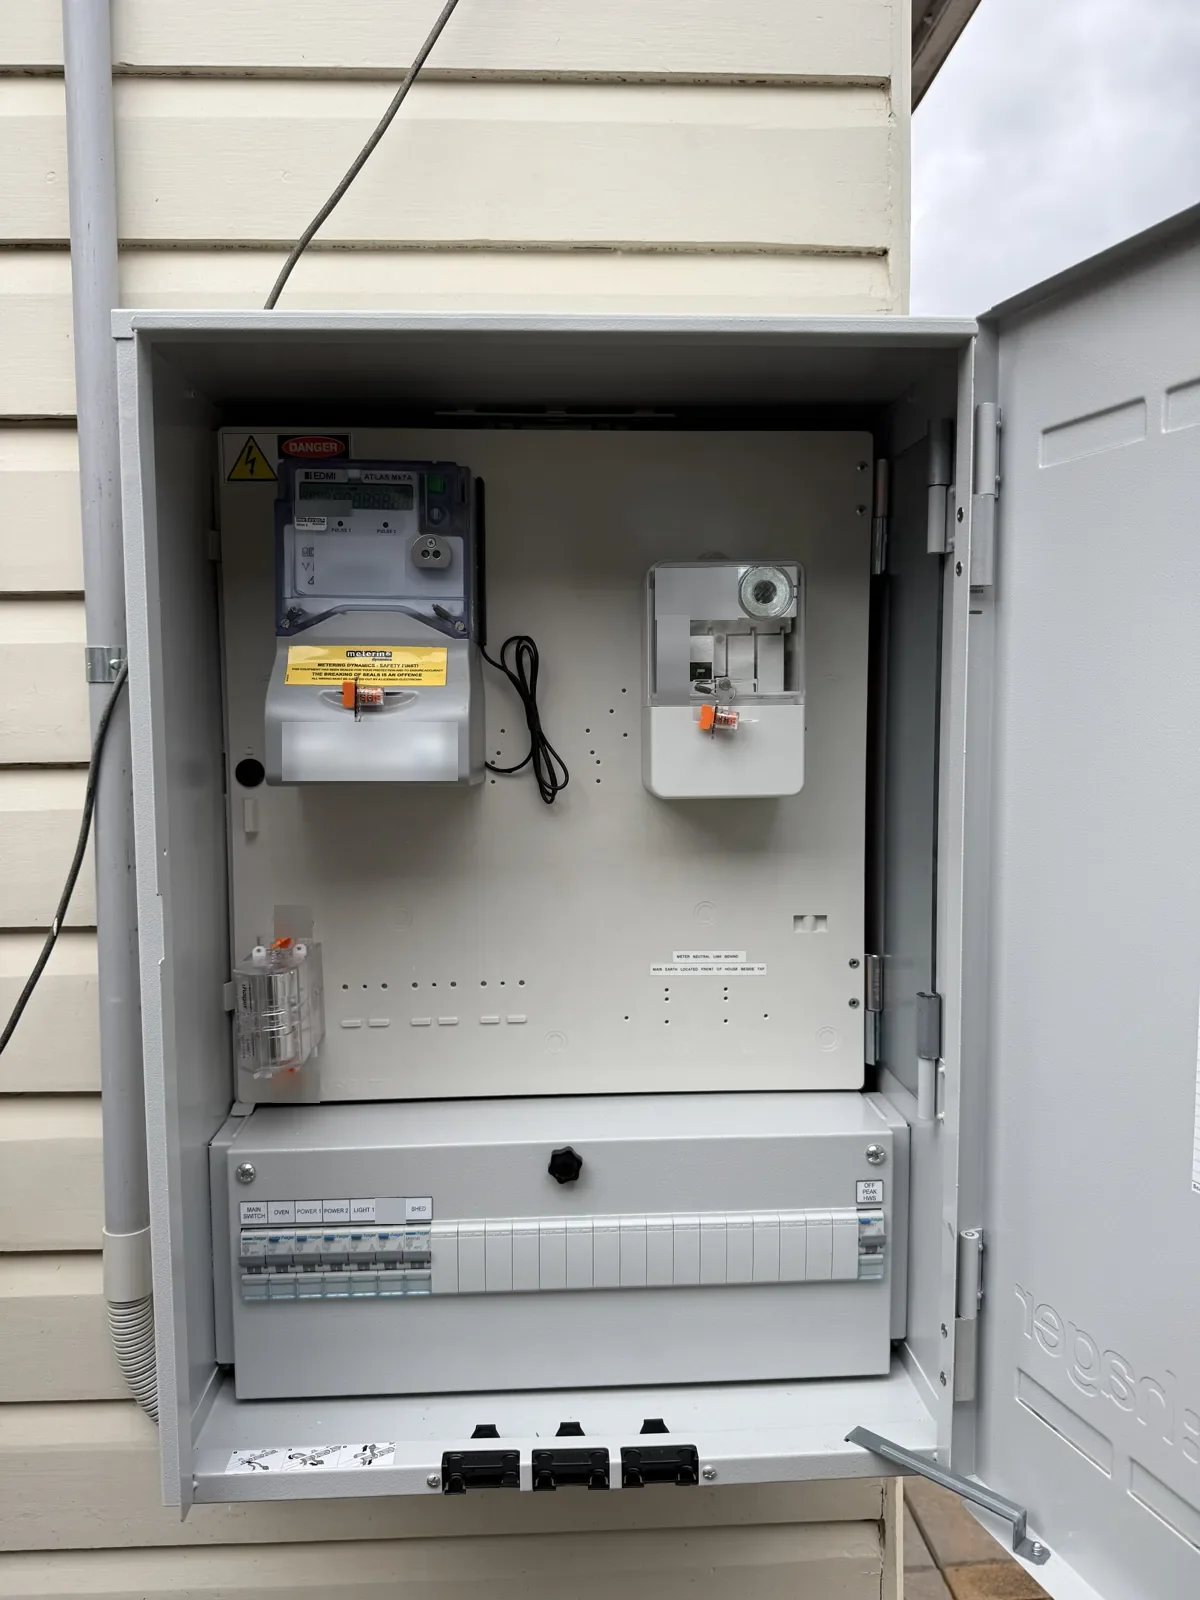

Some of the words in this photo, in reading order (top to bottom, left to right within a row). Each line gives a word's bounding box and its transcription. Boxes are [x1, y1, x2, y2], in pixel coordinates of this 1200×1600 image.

[289, 441, 338, 453] DANGER
[313, 472, 336, 480] EDMI
[364, 473, 390, 481] ATLAS
